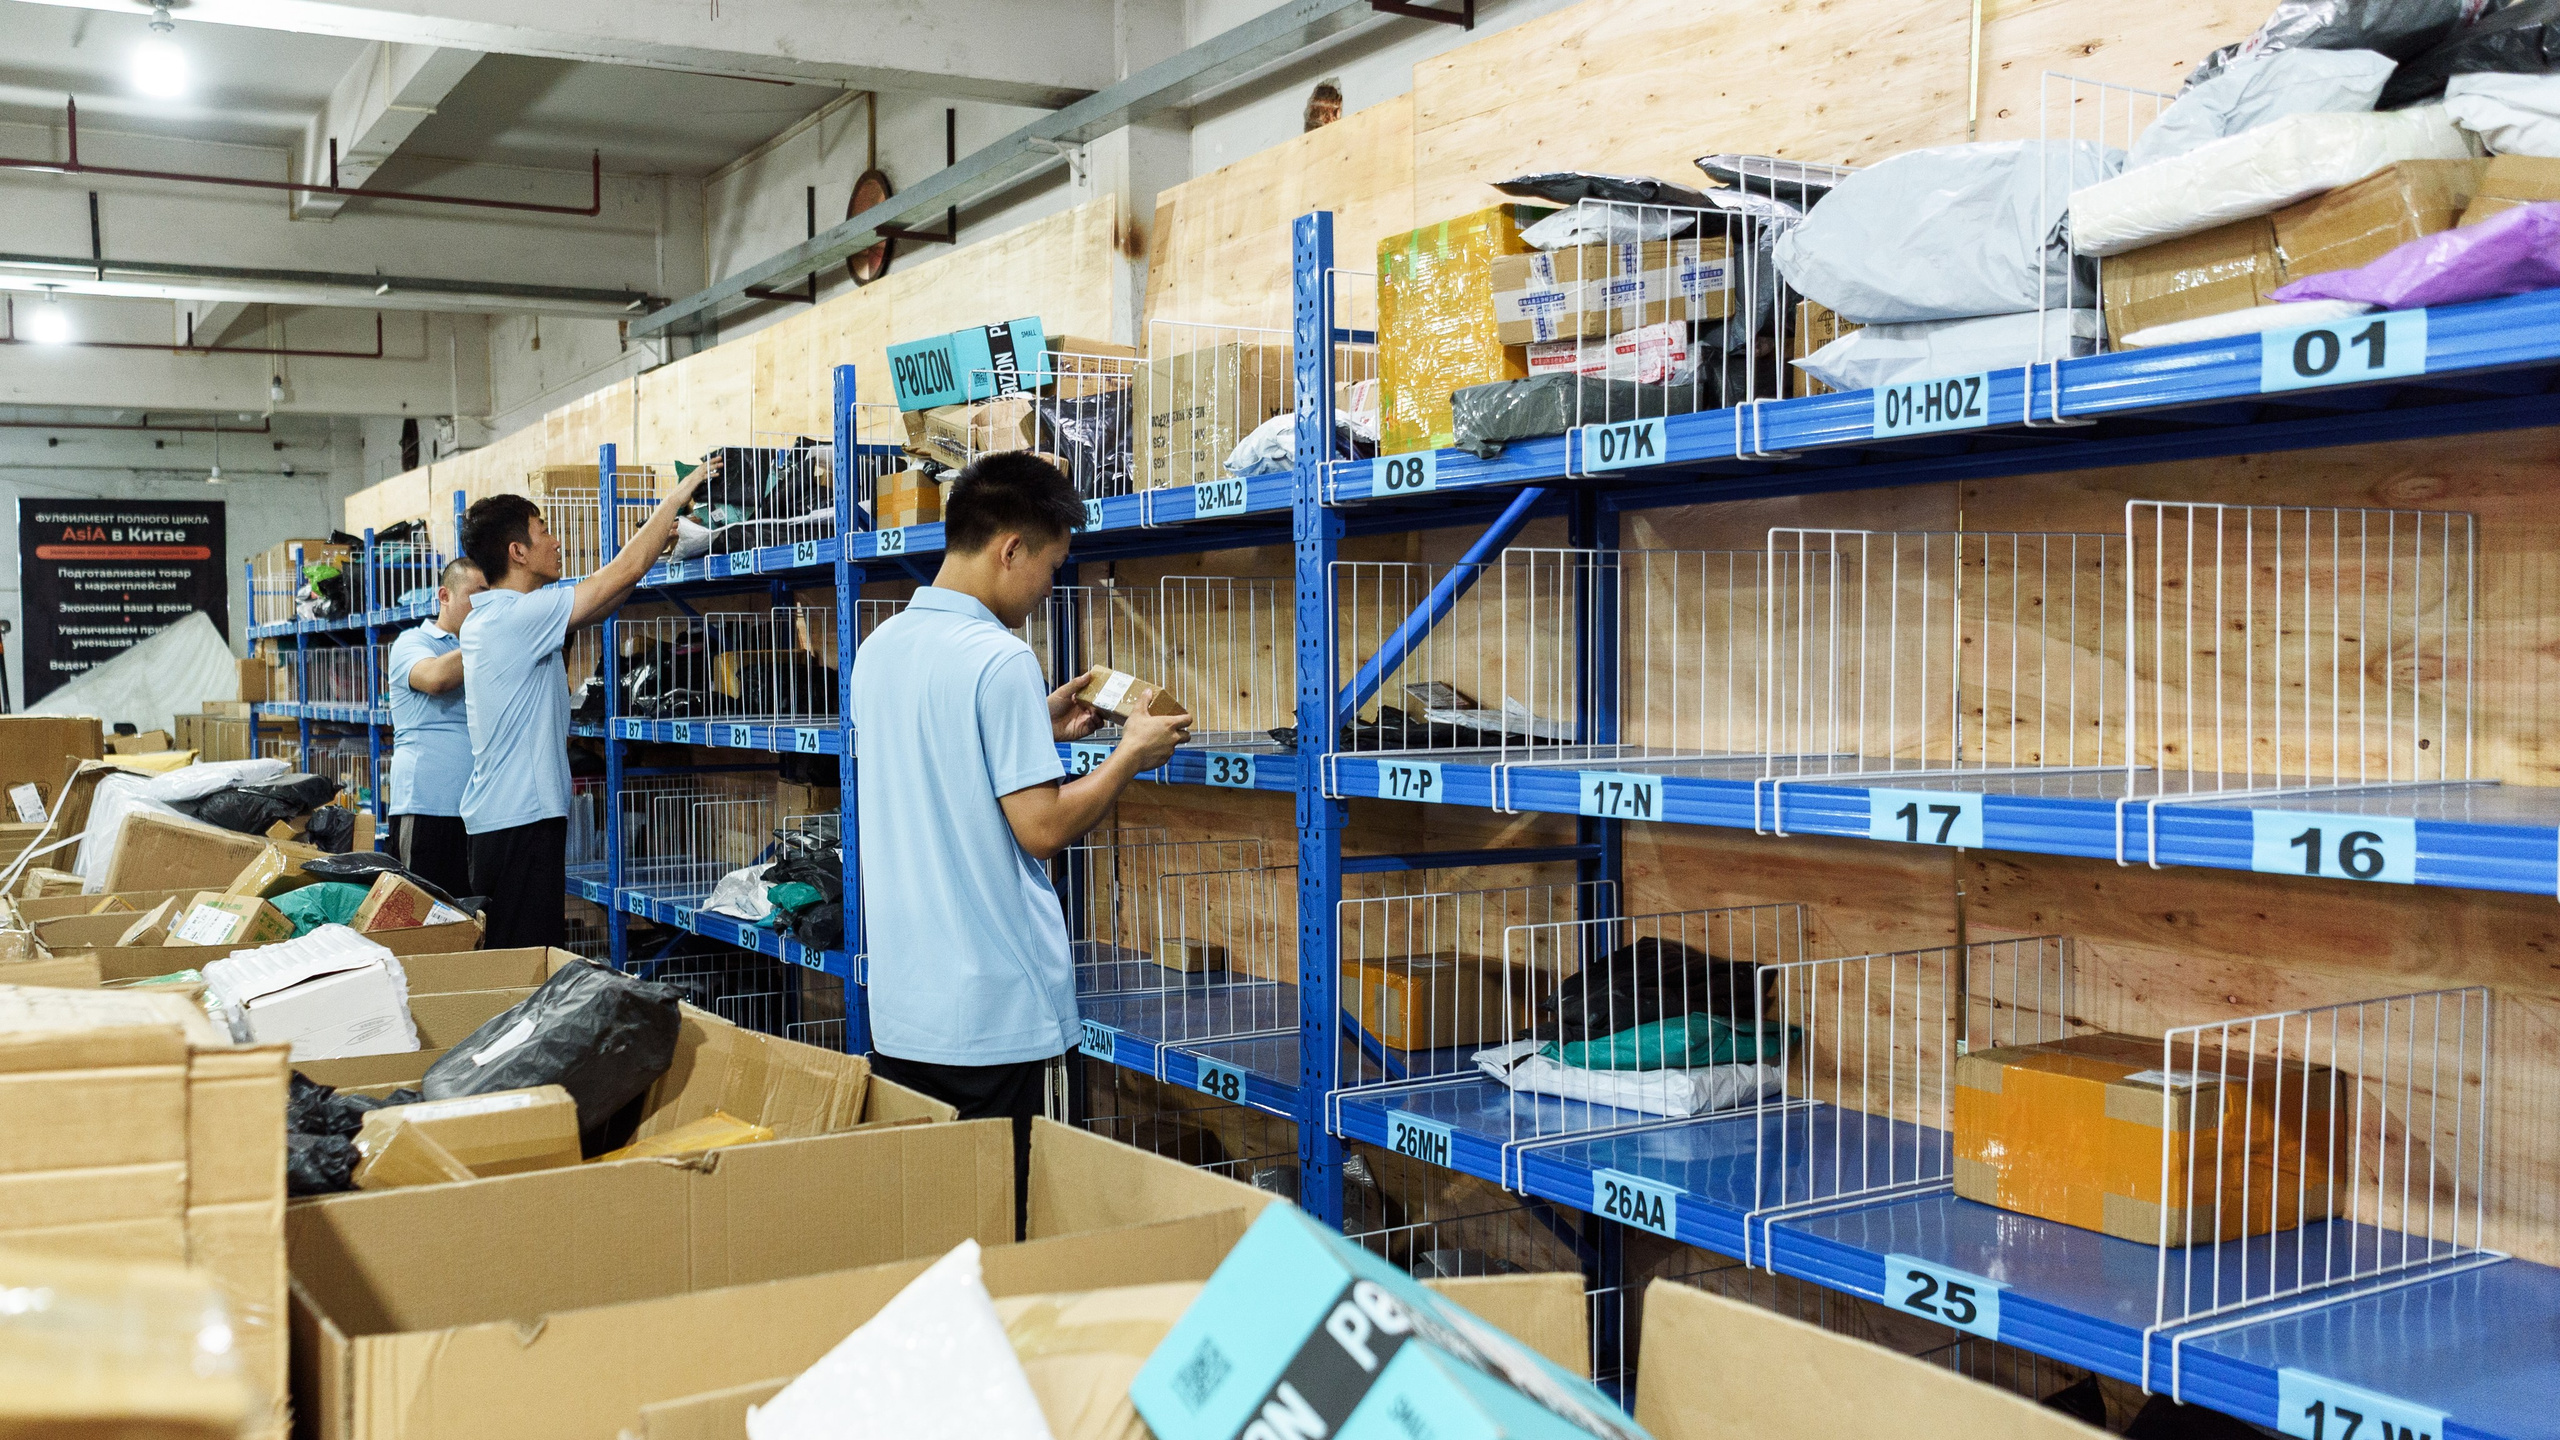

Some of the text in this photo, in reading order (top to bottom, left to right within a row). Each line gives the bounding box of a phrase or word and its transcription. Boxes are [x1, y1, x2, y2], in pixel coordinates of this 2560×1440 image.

[2293, 320, 2386, 378] 01
[1885, 376, 1981, 429] 01-HOZ
[1600, 422, 1656, 464] 07K
[1385, 456, 1425, 491] 08
[1198, 480, 1243, 512] 32-KL2
[35, 513, 210, 526] ФУЛФИЛМЕНТ ПОЛНОГО ЦИКЛА
[1086, 502, 1101, 525] L3
[62, 525, 187, 542] AsiA в Китае
[881, 529, 903, 551] 32
[731, 551, 751, 571] 64-22
[797, 543, 814, 562] 64
[57, 567, 192, 580] Подготавливаем товар
[668, 563, 682, 579] 67
[85, 580, 176, 592] маркетплейсам
[58, 603, 192, 614] Экономим ваше время
[57, 624, 138, 636] Увеличиваем
[72, 638, 133, 650] уменьшая
[49, 659, 89, 673] Ведем
[628, 722, 641, 738] 87
[675, 724, 689, 742] 84
[734, 728, 748, 747] 81
[799, 732, 817, 752] 74
[1212, 756, 1249, 784] 33
[1388, 766, 1433, 799] 17-P
[1593, 780, 1652, 818] 17-N
[1895, 801, 1962, 844] 17
[2289, 827, 2385, 881] 16
[631, 897, 644, 915] 95
[677, 909, 691, 929] 94
[742, 930, 757, 949] 90
[804, 948, 822, 969] 89
[1080, 1024, 1113, 1057] 7-24AN
[1201, 1067, 1240, 1101] 48
[1395, 1121, 1448, 1167] 26MH
[1603, 1180, 1667, 1232] 26AA
[1903, 1269, 1978, 1326] 25
[2305, 1399, 2432, 1440] 17
